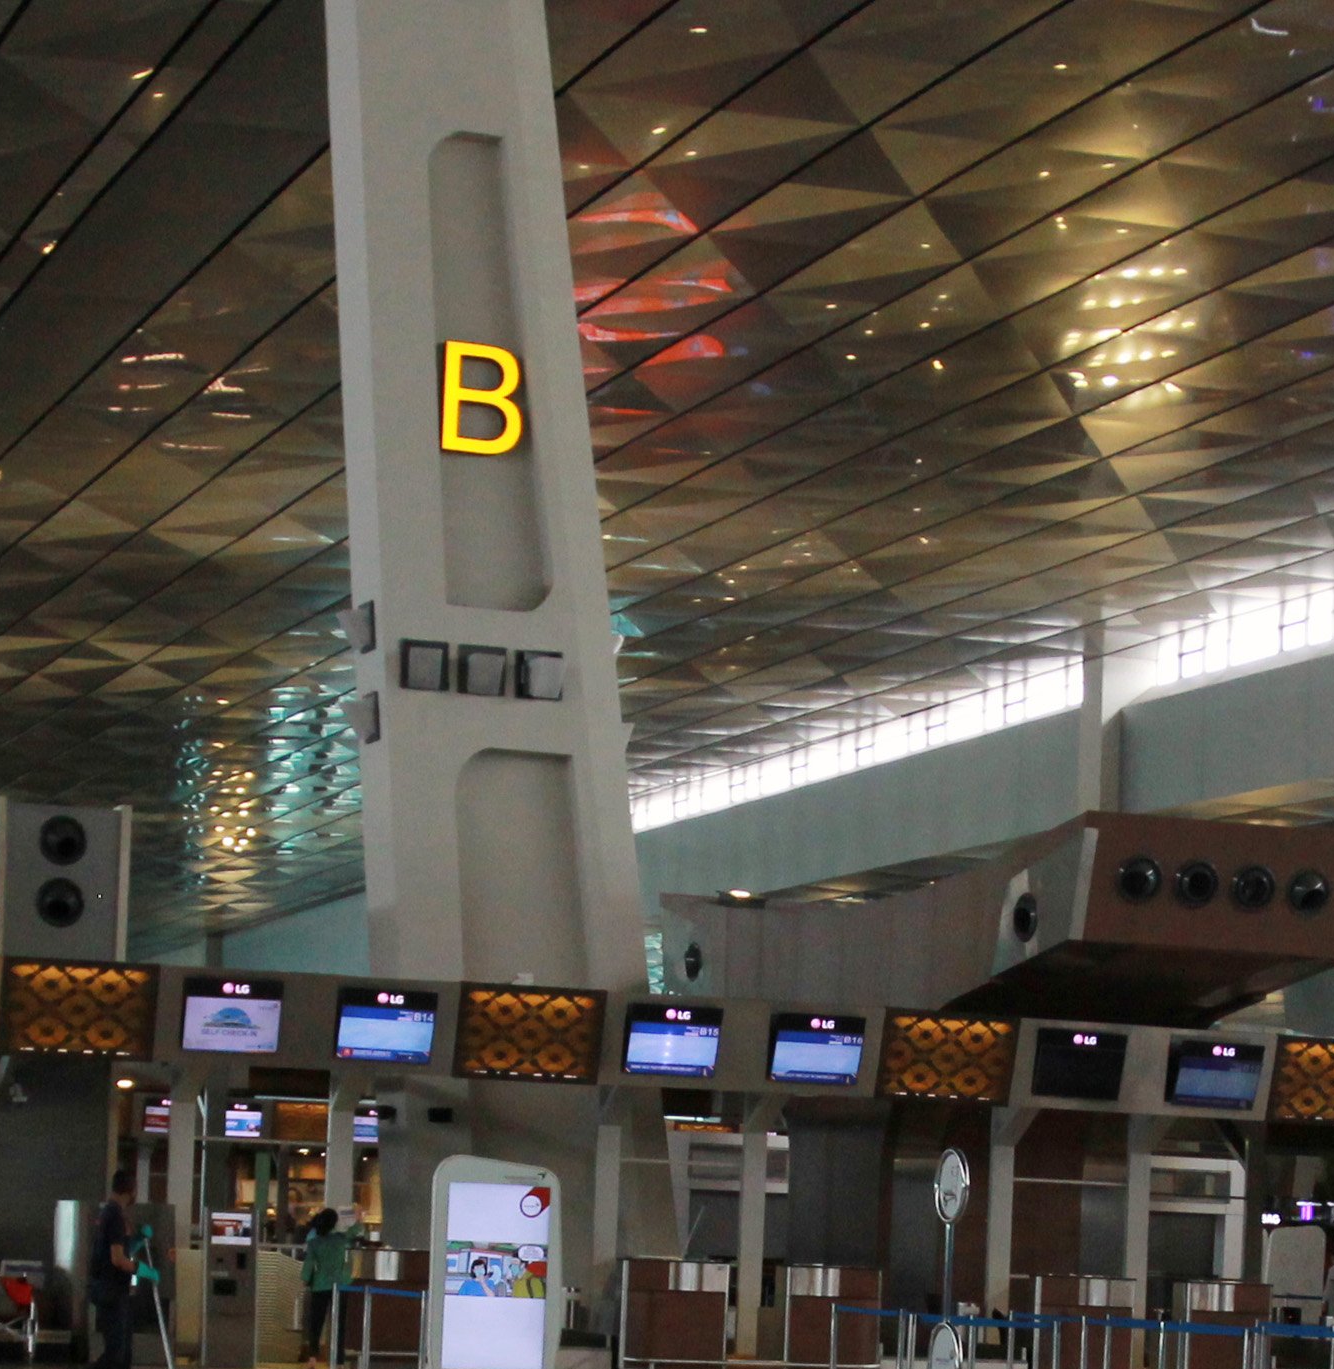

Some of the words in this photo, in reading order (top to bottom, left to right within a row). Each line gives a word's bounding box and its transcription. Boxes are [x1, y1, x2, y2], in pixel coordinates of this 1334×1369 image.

[439, 340, 524, 456] B
[413, 1012, 434, 1022] B14
[699, 1027, 719, 1036] B15
